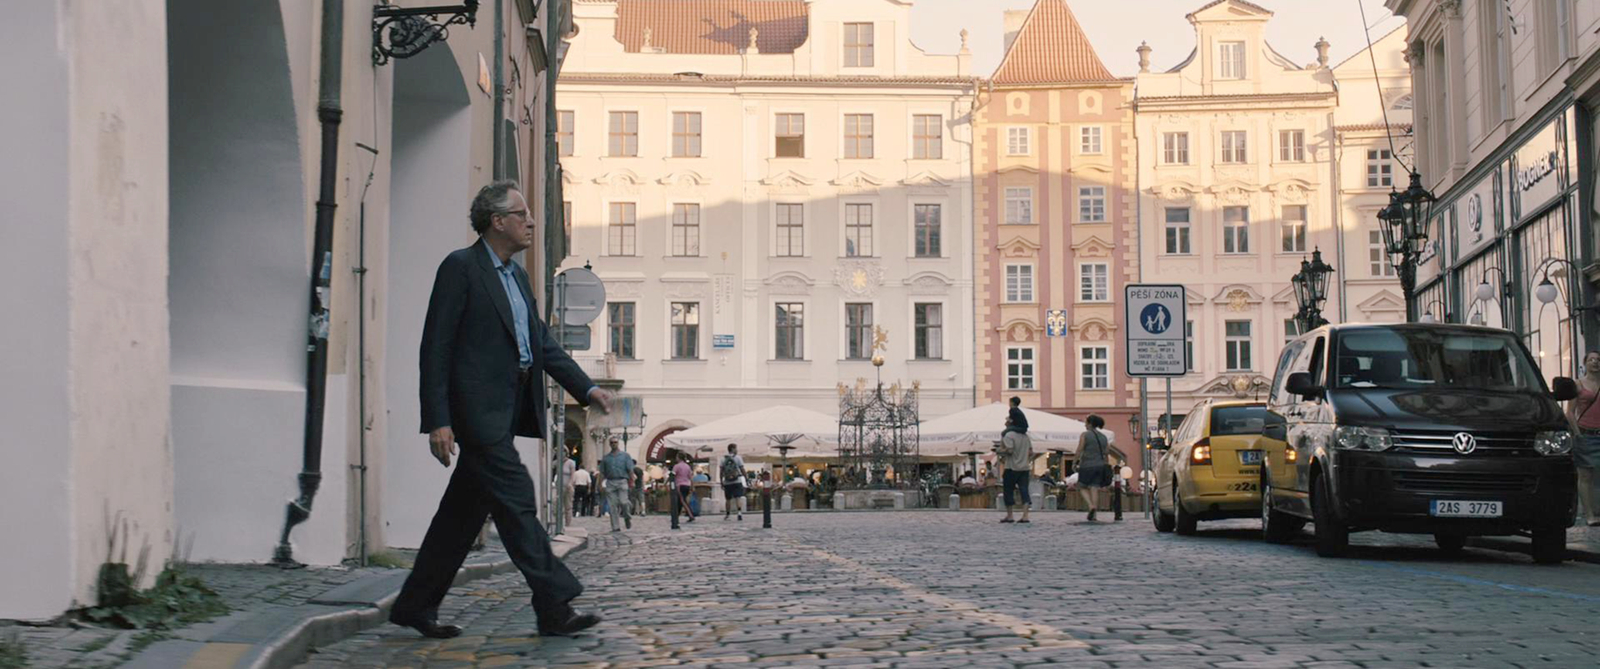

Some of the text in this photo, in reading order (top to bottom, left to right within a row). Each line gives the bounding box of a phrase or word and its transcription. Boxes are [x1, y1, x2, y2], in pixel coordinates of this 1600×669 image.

[1518, 152, 1551, 191] BOGNER
[1130, 289, 1179, 299] PĚŠÍ ZÓNA
[1234, 481, 1256, 491] 224
[1439, 502, 1497, 514] 2AS 3779
